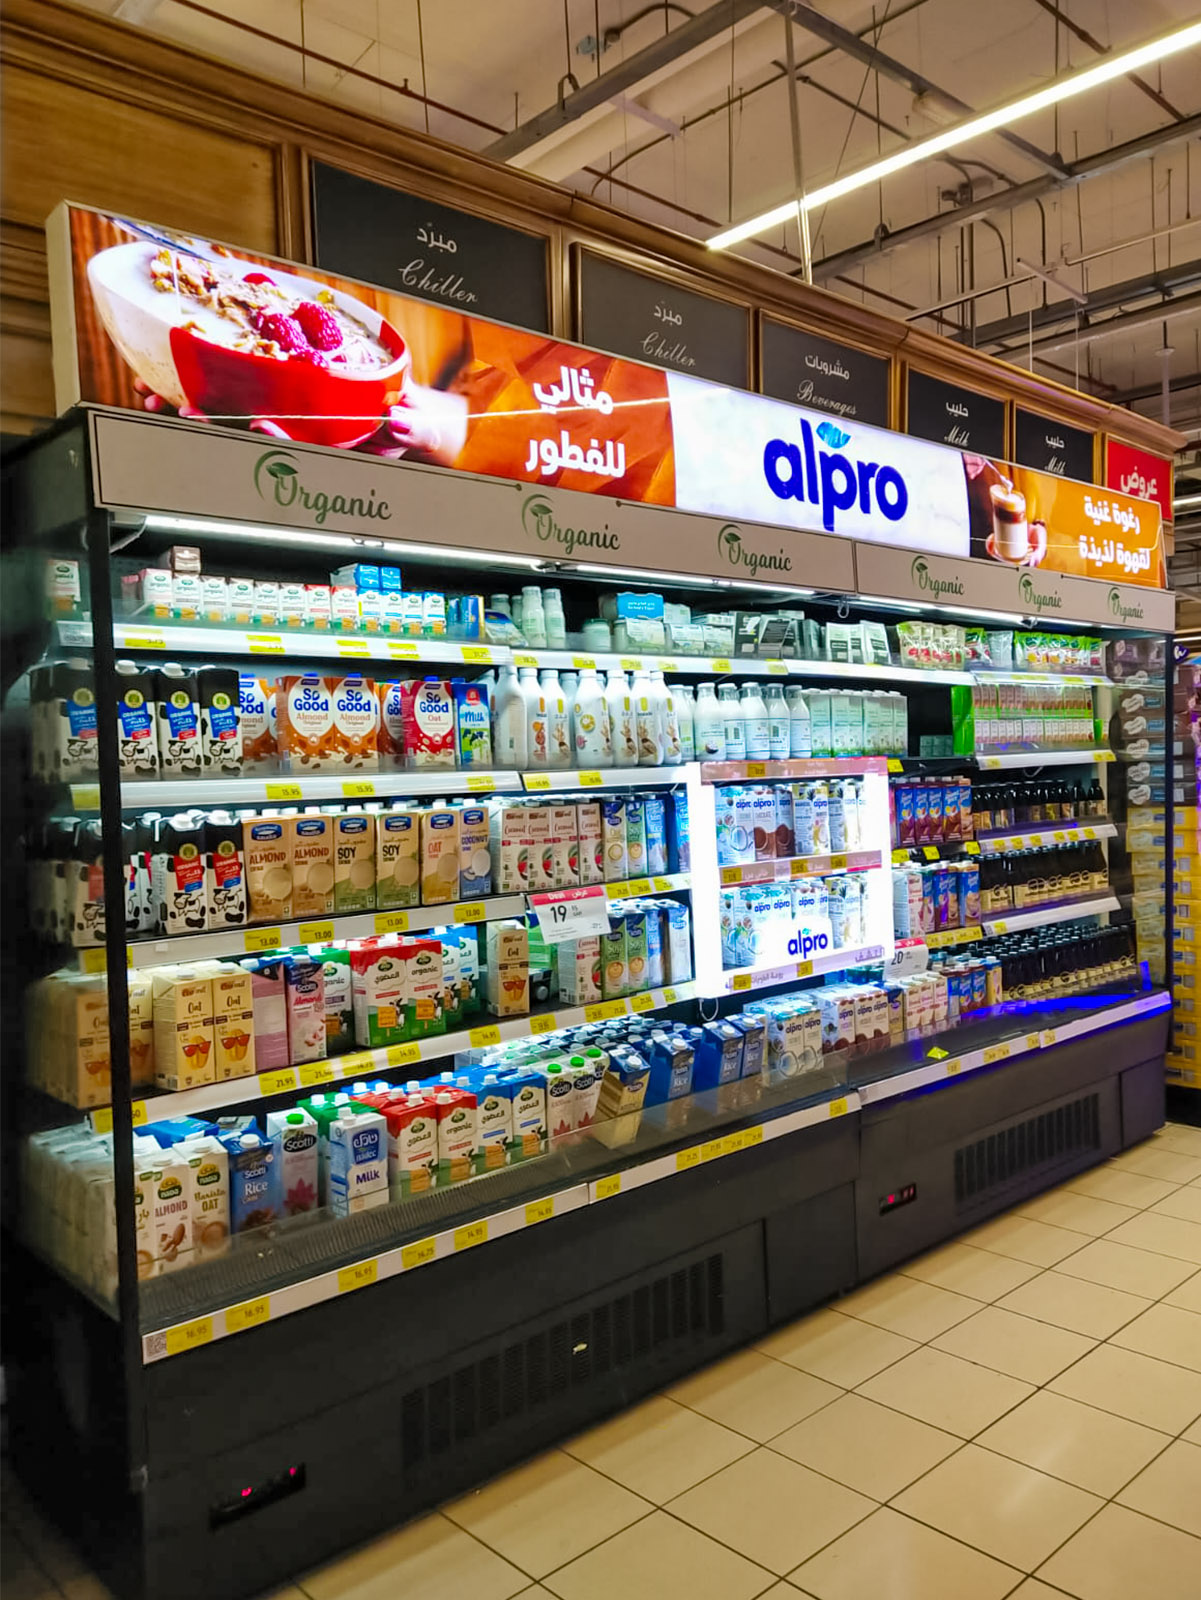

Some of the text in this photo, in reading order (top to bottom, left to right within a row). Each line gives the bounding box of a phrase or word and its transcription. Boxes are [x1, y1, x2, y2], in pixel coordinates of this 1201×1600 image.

[398, 259, 478, 303] Chiller
[640, 331, 696, 367] Chiller
[804, 354, 850, 381] مشروبات
[533, 365, 613, 415] مثالي
[797, 379, 858, 416] Beverages
[944, 425, 970, 447] Milk
[525, 430, 626, 478] للفطور
[763, 417, 908, 531] alpro
[274, 475, 392, 524] Organic
[535, 513, 621, 555] Organic
[728, 539, 792, 577] Organic
[918, 569, 965, 598] Organic
[1025, 582, 1063, 610] Organic
[1110, 597, 1144, 621] Organic
[303, 688, 320, 700] So
[346, 690, 362, 701] So
[426, 692, 440, 703] So
[240, 702, 264, 714] ood
[294, 699, 329, 711] Good
[337, 699, 371, 712] Good
[420, 702, 448, 713] Good
[294, 847, 330, 859] ALMOND
[337, 847, 356, 859] SOY
[382, 844, 400, 856] SOY
[428, 841, 442, 853] OAT
[249, 852, 286, 865] ALMOND
[550, 905, 567, 924] 19
[387, 918, 403, 926] 13.00
[314, 930, 332, 939] 13.00
[260, 937, 279, 946] 13.00
[788, 930, 828, 959] alpro
[891, 951, 903, 966] 20
[411, 966, 438, 976] organic
[324, 978, 345, 987] ganic
[786, 1023, 802, 1035] alpro
[446, 1122, 472, 1135] organic
[286, 1137, 314, 1152] Scotti
[244, 1167, 266, 1179] Scotti
[244, 1181, 269, 1196] Rice
[154, 1200, 188, 1217] ALMOND
[202, 1199, 219, 1212] OAT
